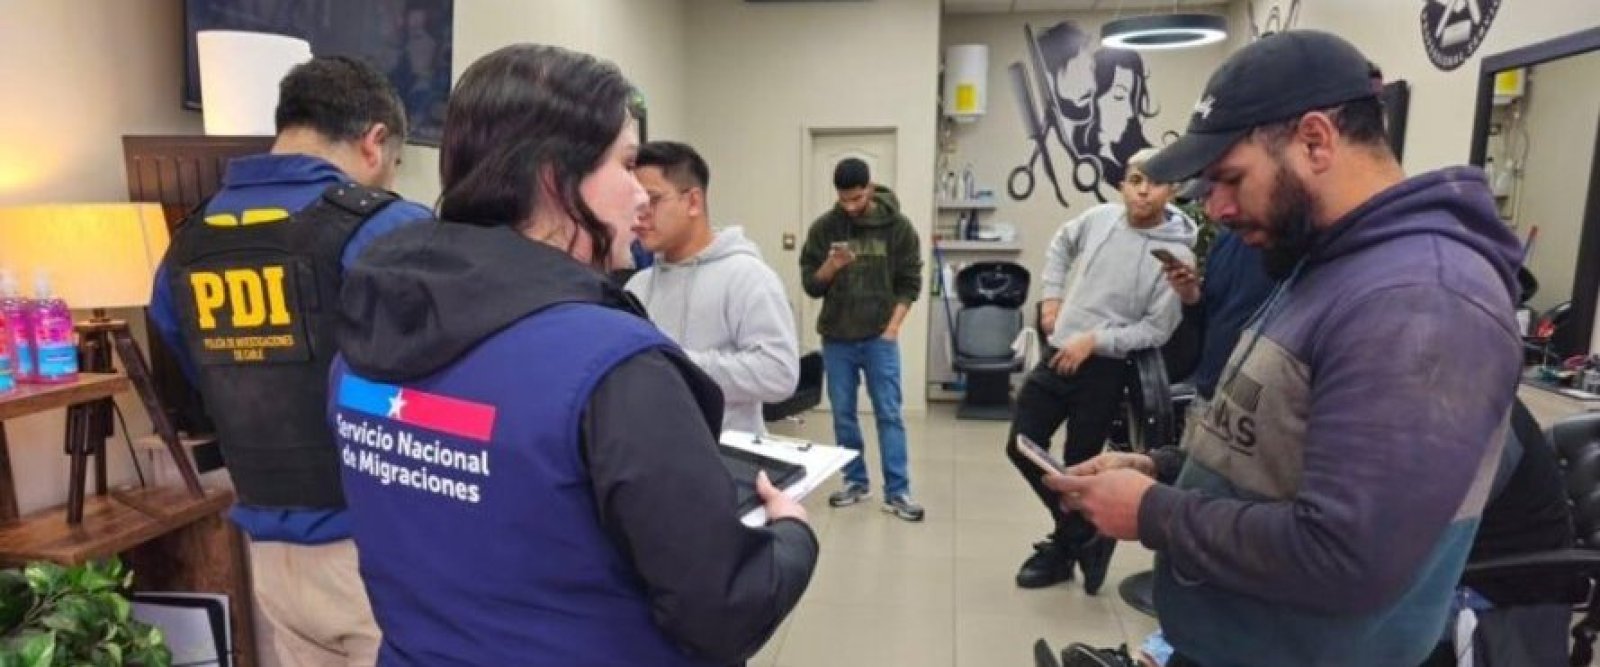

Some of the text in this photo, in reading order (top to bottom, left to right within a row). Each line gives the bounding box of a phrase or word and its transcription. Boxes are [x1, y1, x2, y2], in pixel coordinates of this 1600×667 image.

[190, 266, 291, 329] PDI
[343, 444, 480, 503] de Migraciones
[397, 430, 490, 476] Nacional
